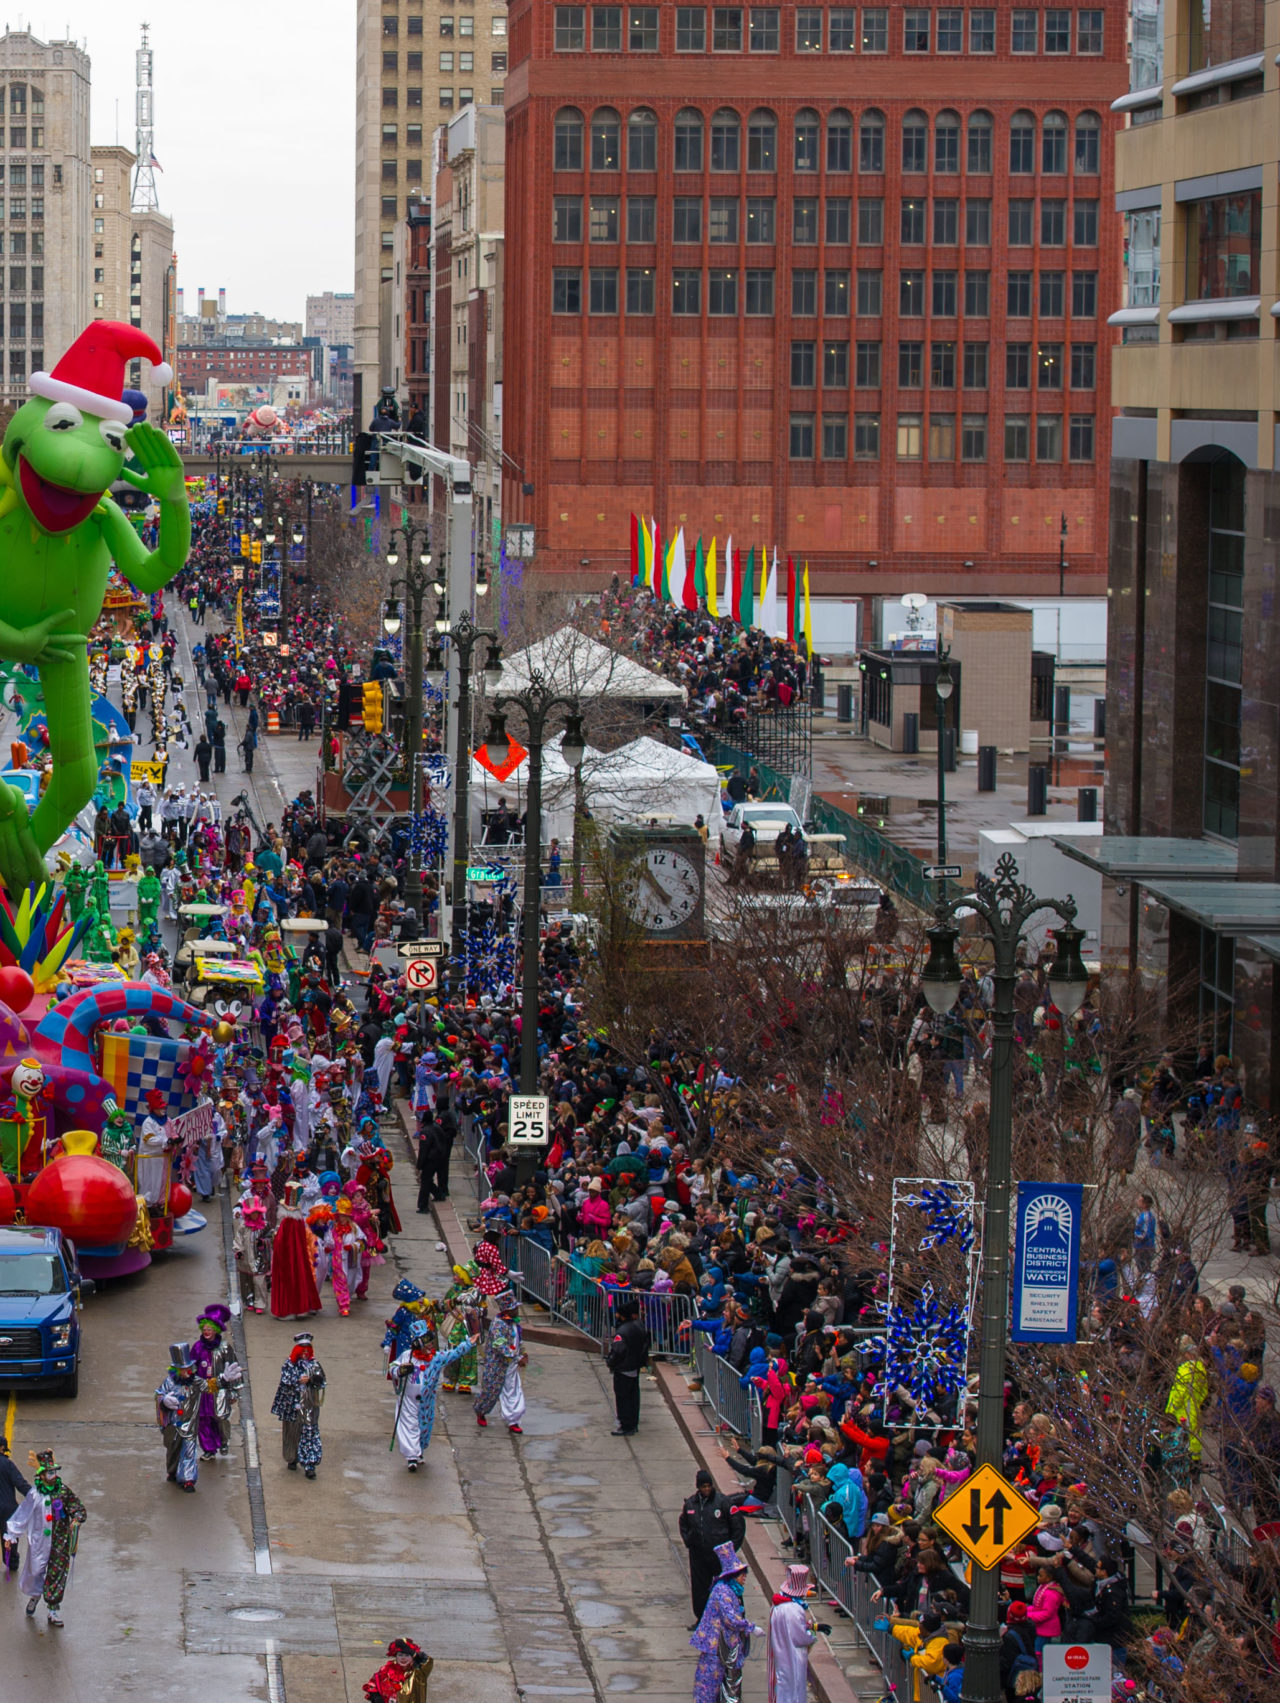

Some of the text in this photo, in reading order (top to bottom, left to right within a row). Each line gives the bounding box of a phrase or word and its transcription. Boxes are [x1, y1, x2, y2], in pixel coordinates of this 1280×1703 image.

[654, 854, 666, 865] 12
[681, 870, 689, 880] 2
[680, 900, 688, 910] 4
[654, 914, 663, 924] 6
[513, 1101, 545, 1110] SPEED
[516, 1111, 541, 1119] LIMIT
[513, 1121, 544, 1139] 25
[1026, 1253, 1067, 1261] BUSINESS
[1026, 1273, 1066, 1282] WATCH
